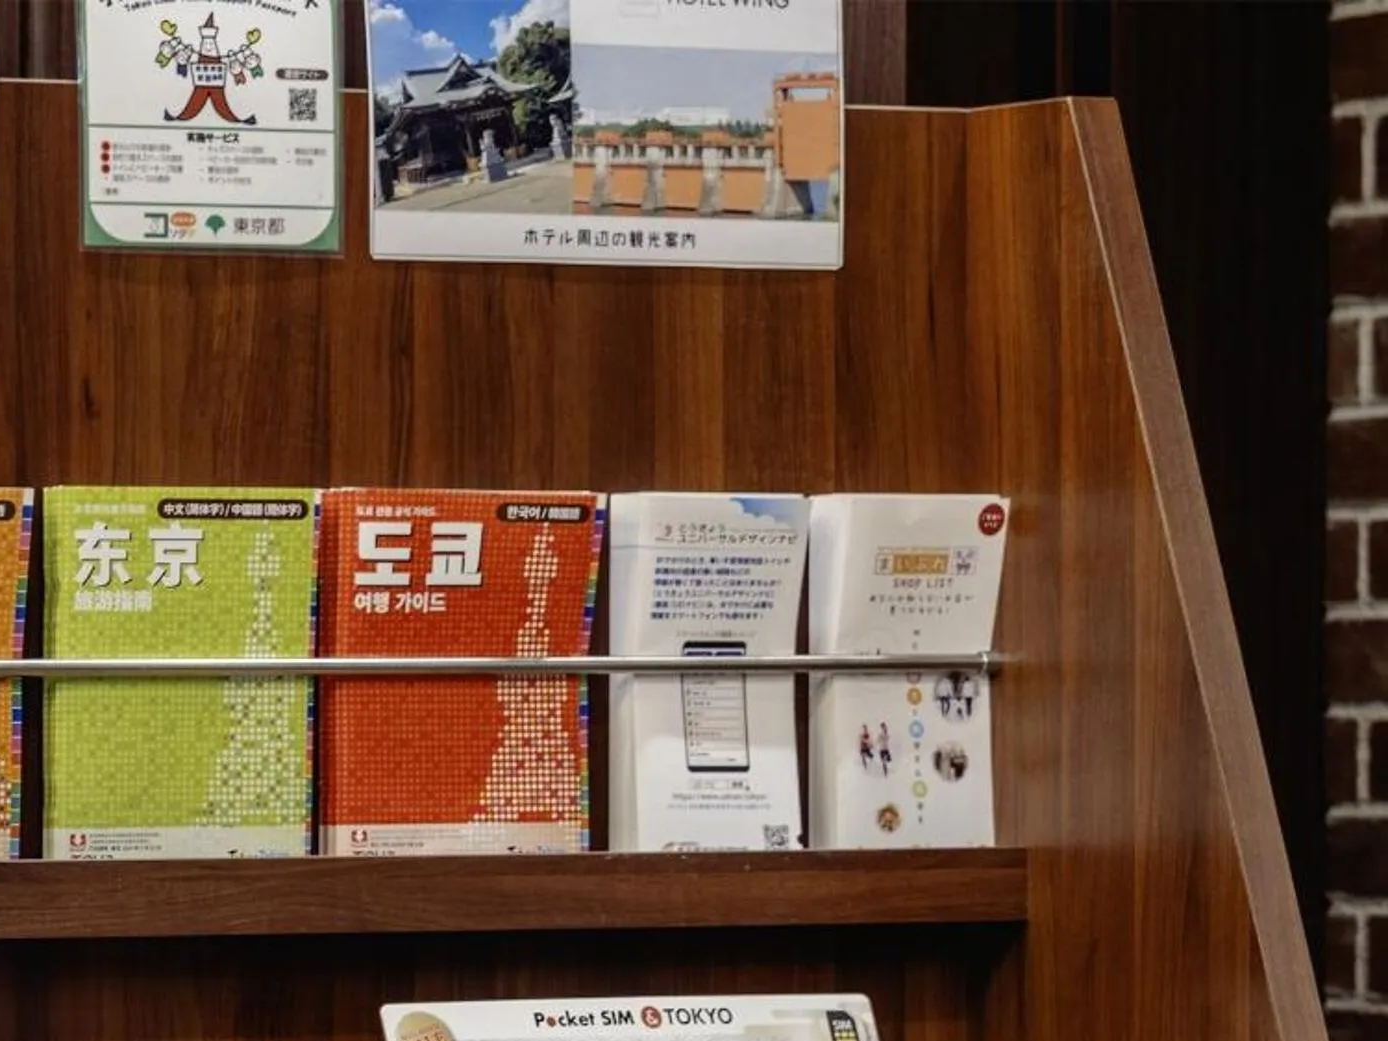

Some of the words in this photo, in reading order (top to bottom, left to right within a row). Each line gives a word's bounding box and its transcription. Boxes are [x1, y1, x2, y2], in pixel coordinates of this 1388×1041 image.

[233, 217, 285, 235] 東京都
[522, 228, 697, 250] ホテル周辺の観光案内
[506, 506, 540, 520] 한국어
[74, 520, 204, 588] 东京
[354, 522, 484, 586] 도쿄
[354, 592, 390, 613] 여행
[395, 592, 447, 613] 가이드
[534, 1010, 596, 1028] Pocket
[601, 1008, 635, 1026] SIM
[664, 1007, 734, 1026] TOKYO
